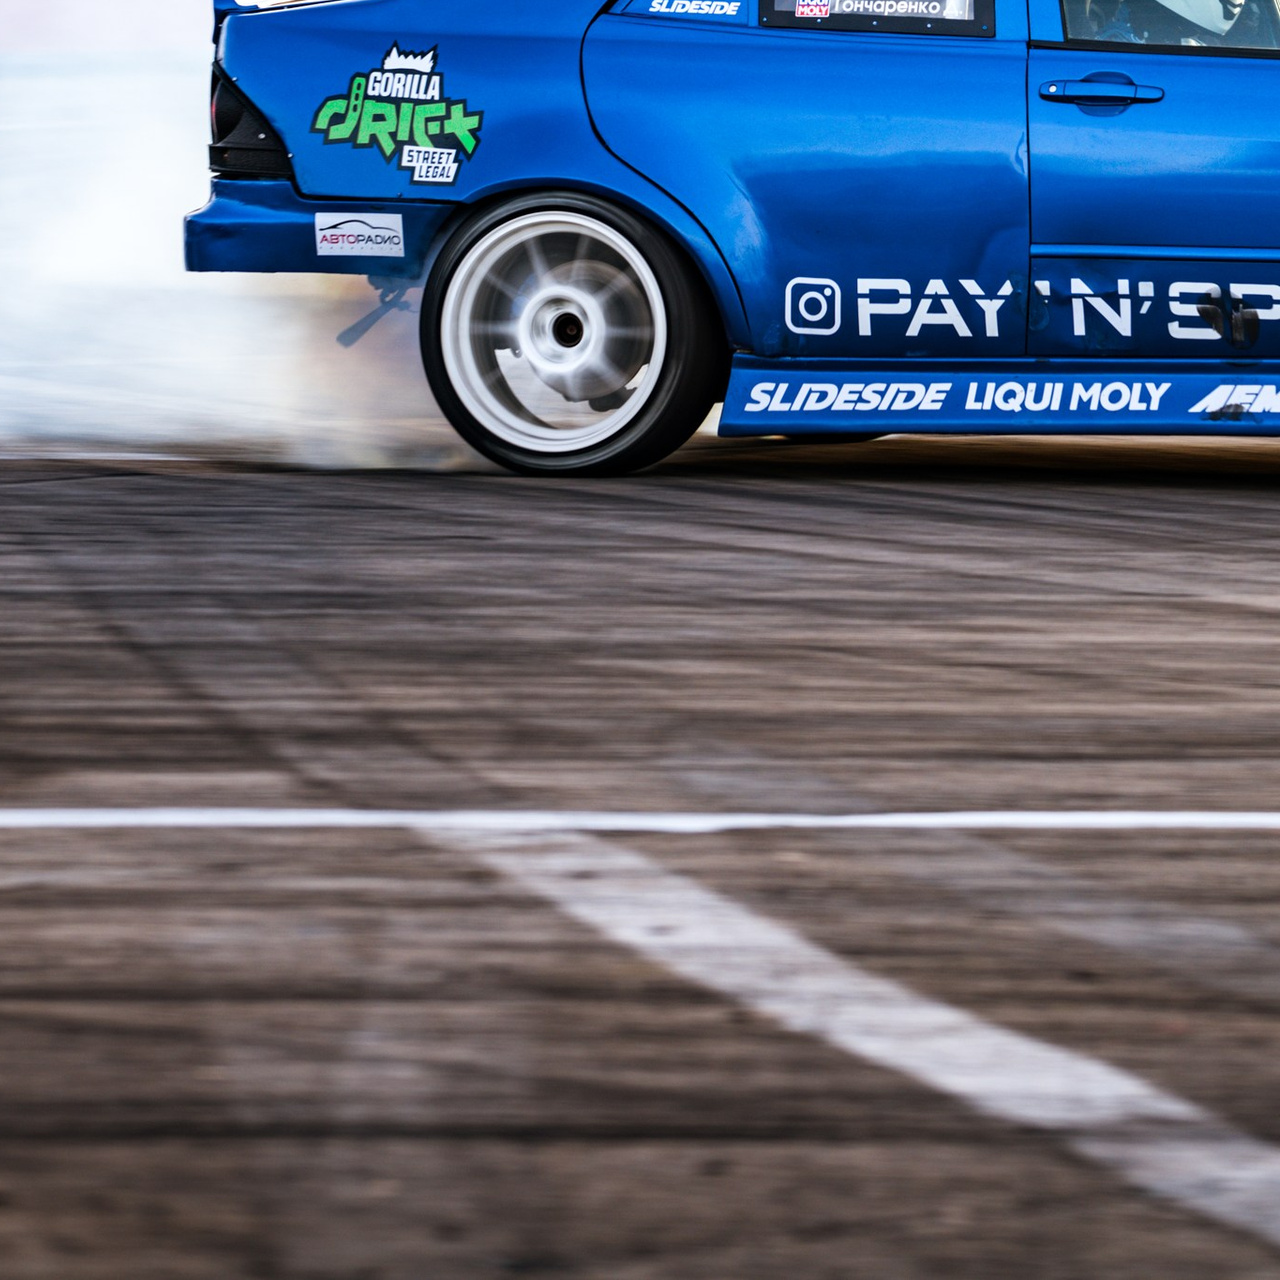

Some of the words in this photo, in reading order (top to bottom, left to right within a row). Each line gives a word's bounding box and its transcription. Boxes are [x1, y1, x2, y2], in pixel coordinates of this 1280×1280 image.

[649, 0, 741, 15] SLIDESIDE
[798, 6, 829, 16] MOLY
[367, 71, 440, 100] GORILLA
[407, 149, 453, 165] STREET
[418, 165, 452, 179] LEGAL
[857, 279, 1014, 337] PAY
[745, 382, 953, 412] SLIDESIDE
[965, 382, 1064, 413] LIQUI
[1069, 382, 1172, 411] MOLY
